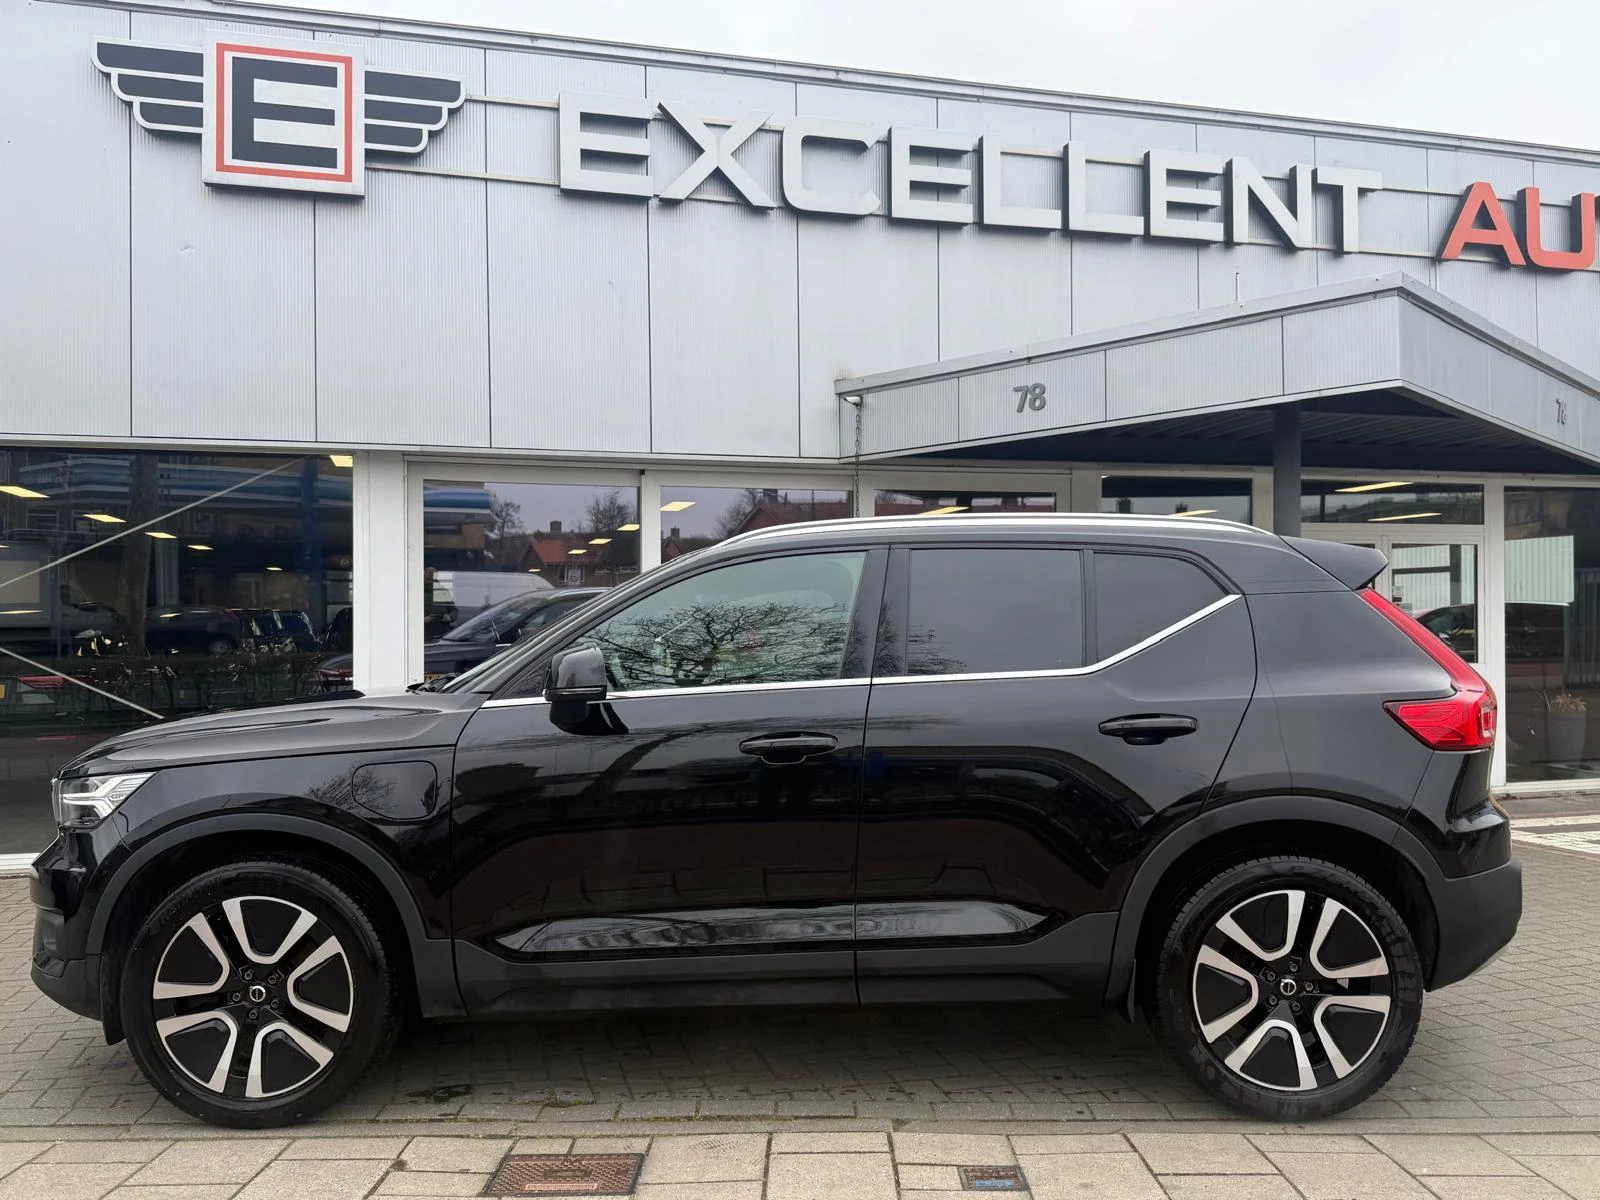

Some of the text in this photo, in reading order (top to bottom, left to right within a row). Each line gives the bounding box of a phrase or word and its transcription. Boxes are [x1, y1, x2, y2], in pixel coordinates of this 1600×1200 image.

[232, 56, 338, 169] E
[558, 91, 1600, 269] EXCELLENT AU
[1013, 383, 1046, 413] 78
